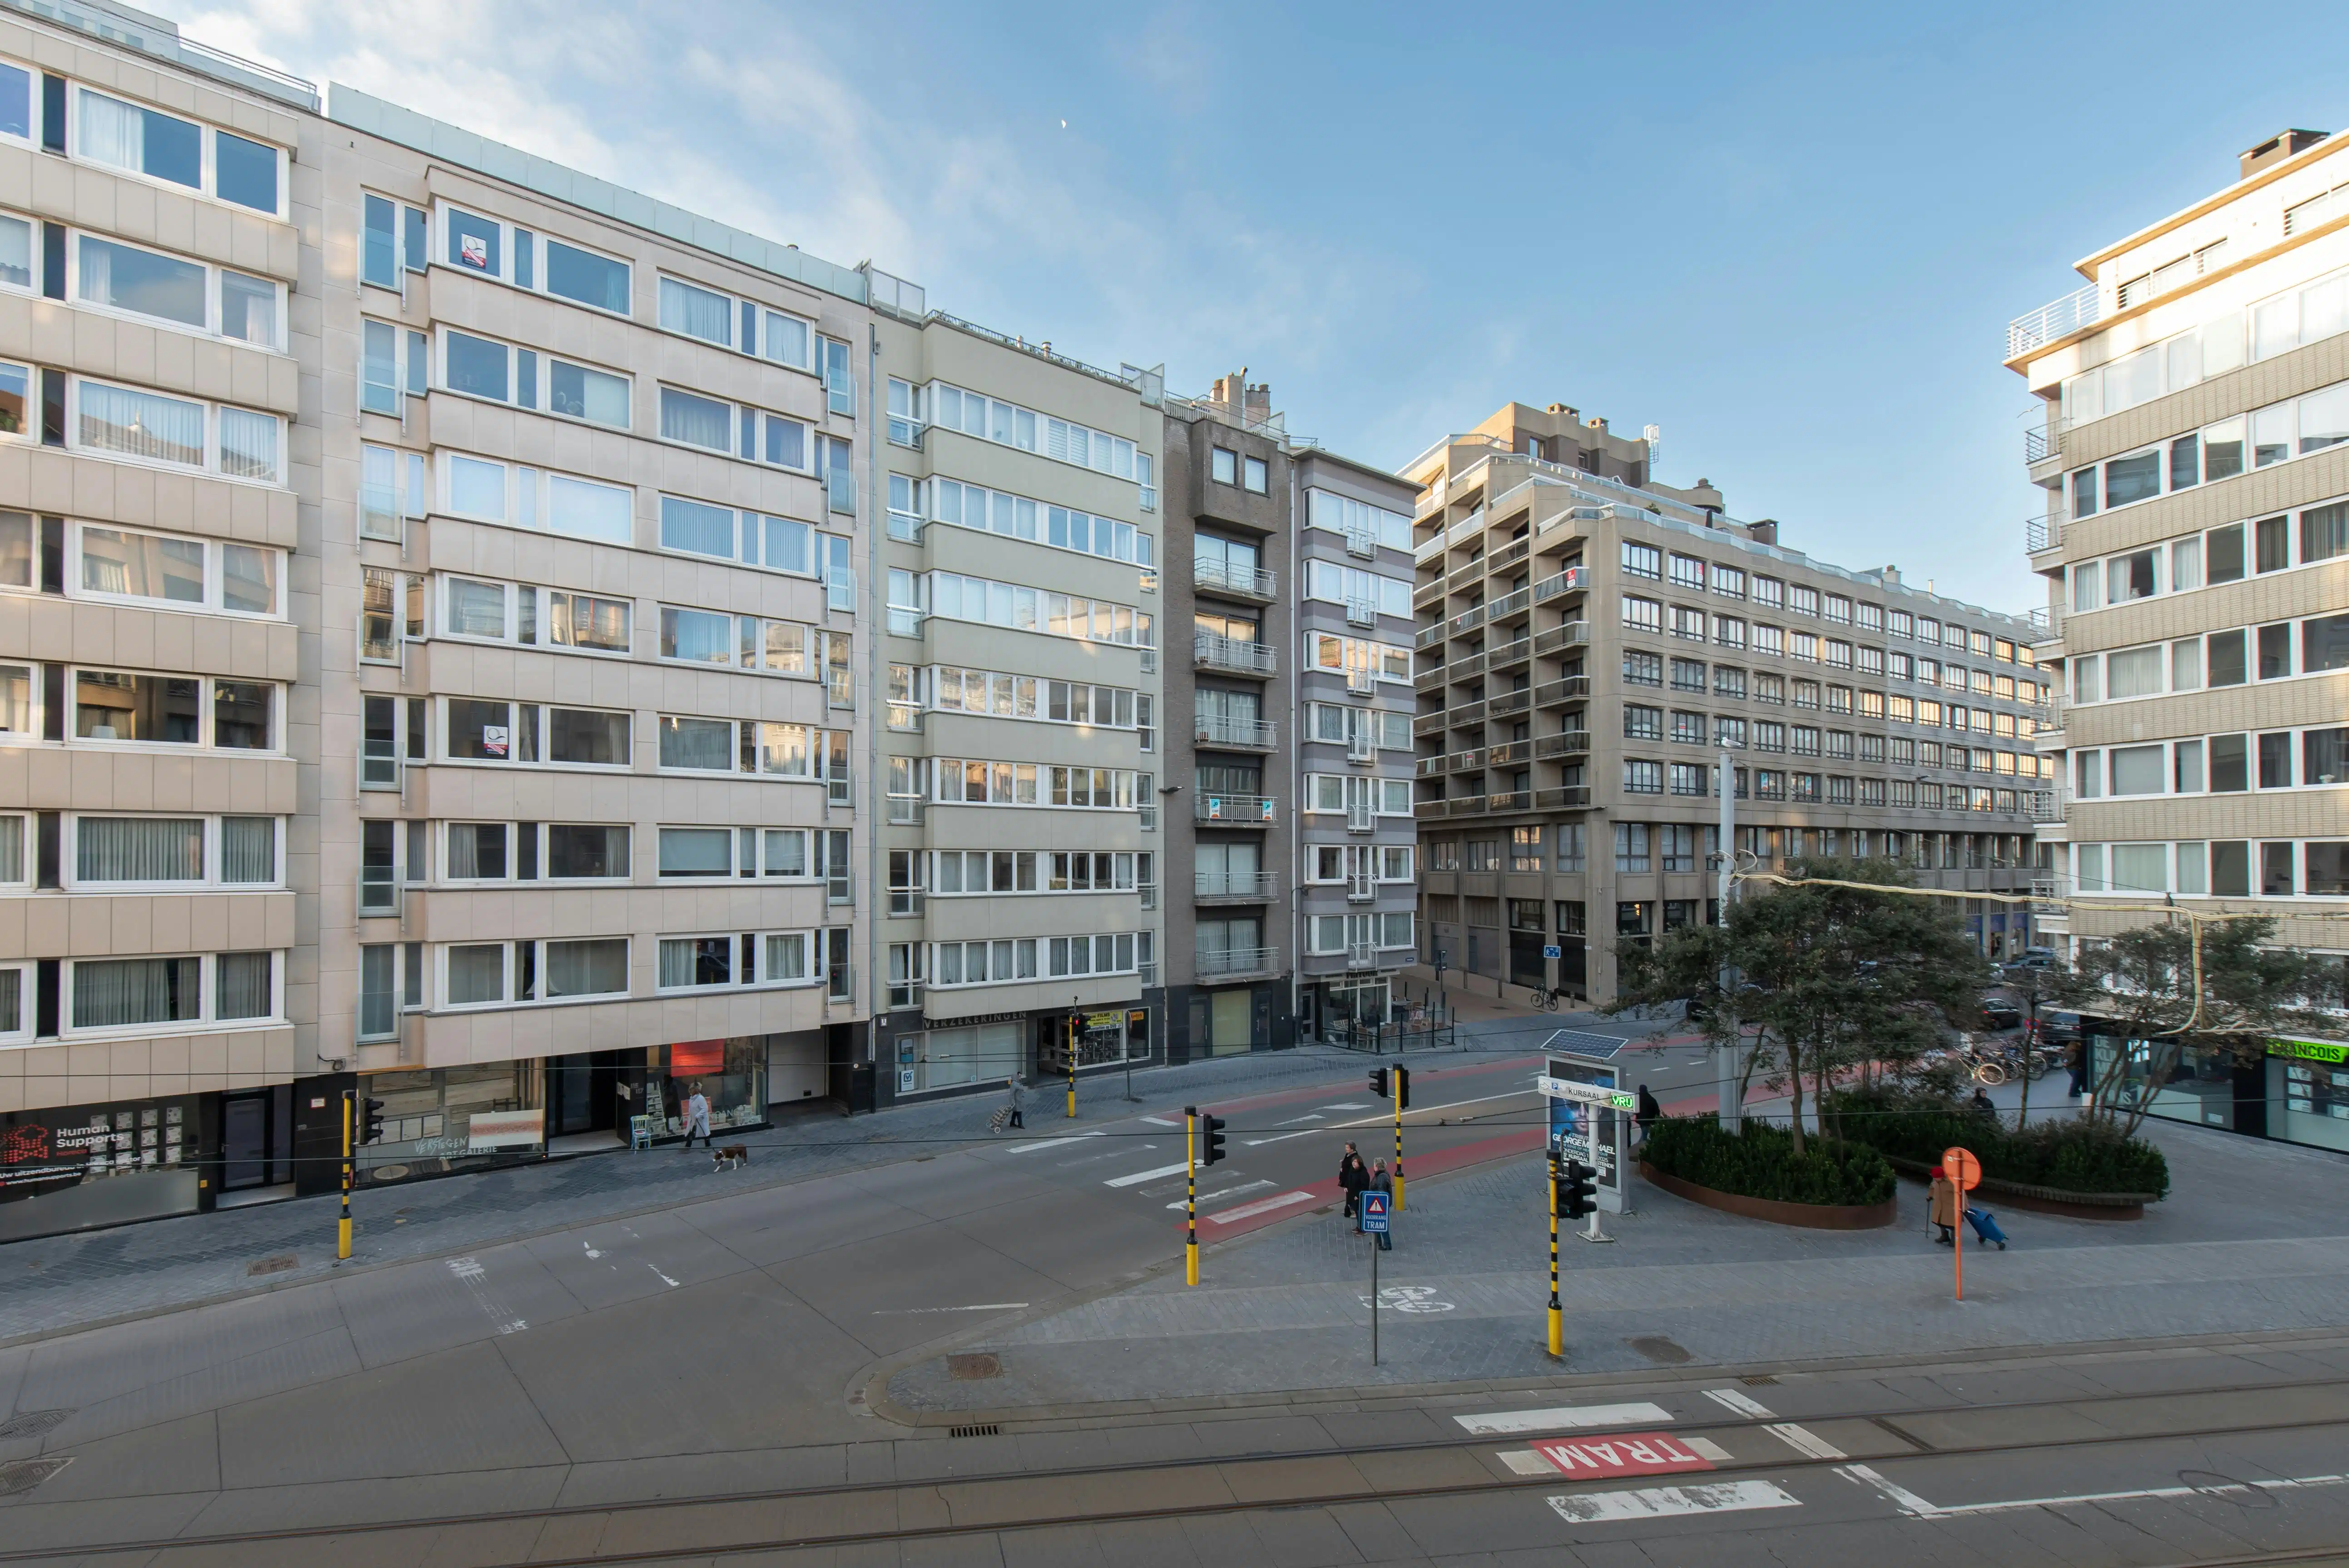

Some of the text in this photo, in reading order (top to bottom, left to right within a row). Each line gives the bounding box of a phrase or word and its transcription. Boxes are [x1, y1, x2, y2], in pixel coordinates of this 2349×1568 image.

[924, 1011, 1026, 1029] VERZEKERINGEN
[1568, 1087, 1600, 1100] KURSAAL
[56, 1125, 110, 1138] Human
[1572, 1133, 1590, 1141] TRIBUT
[56, 1133, 124, 1148] Supports
[414, 1135, 469, 1156] VERSTEGEN
[458, 1146, 498, 1157] GALERIE
[1582, 1141, 1615, 1155] MHAEL
[1568, 1154, 1589, 1163] KURSAAL
[15, 1166, 75, 1177] uitzendbureau
[1367, 1221, 1385, 1229] TRAM
[1543, 1439, 1698, 1469] TRAM
